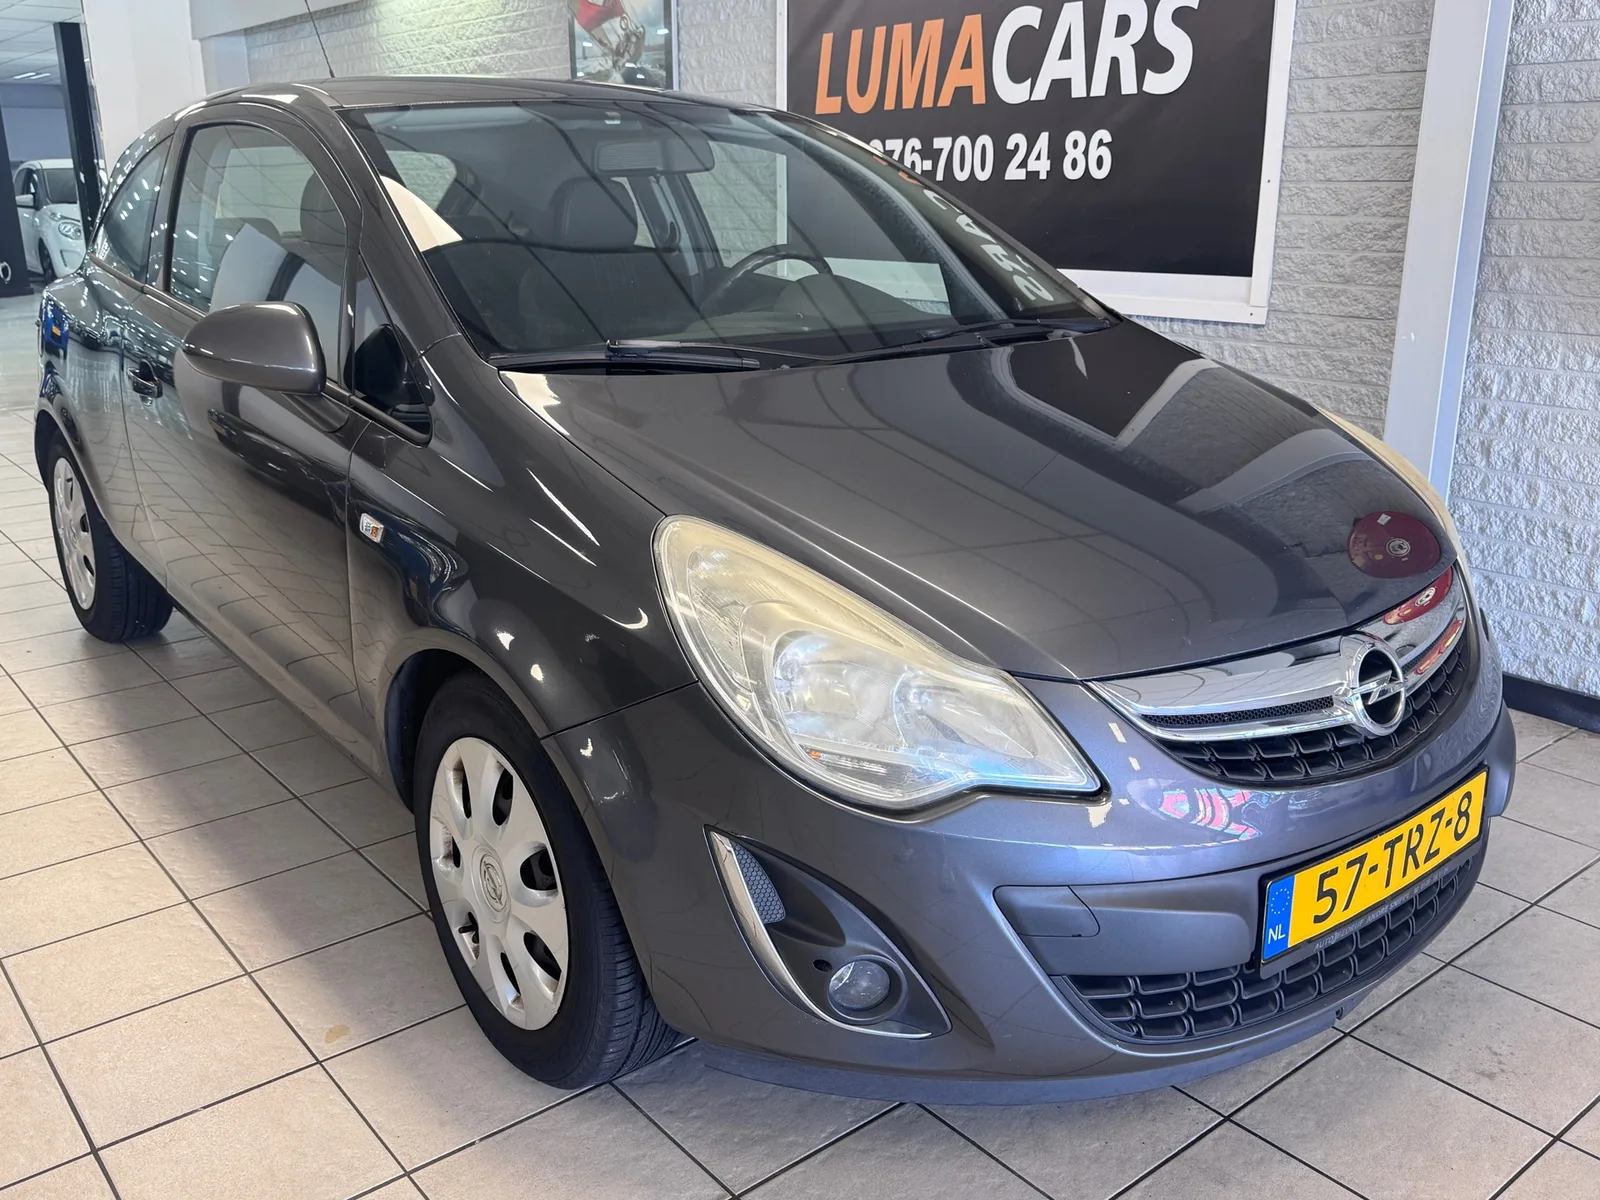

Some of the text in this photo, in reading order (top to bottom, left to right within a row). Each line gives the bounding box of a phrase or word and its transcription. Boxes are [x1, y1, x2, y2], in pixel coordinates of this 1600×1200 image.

[815, 0, 1200, 115] LUMACARS
[868, 134, 994, 182] 76-700
[1004, 132, 1051, 180] 24
[1062, 128, 1113, 180] 86
[1313, 790, 1473, 924] 57-TRZ-8
[1267, 923, 1286, 945] NL
